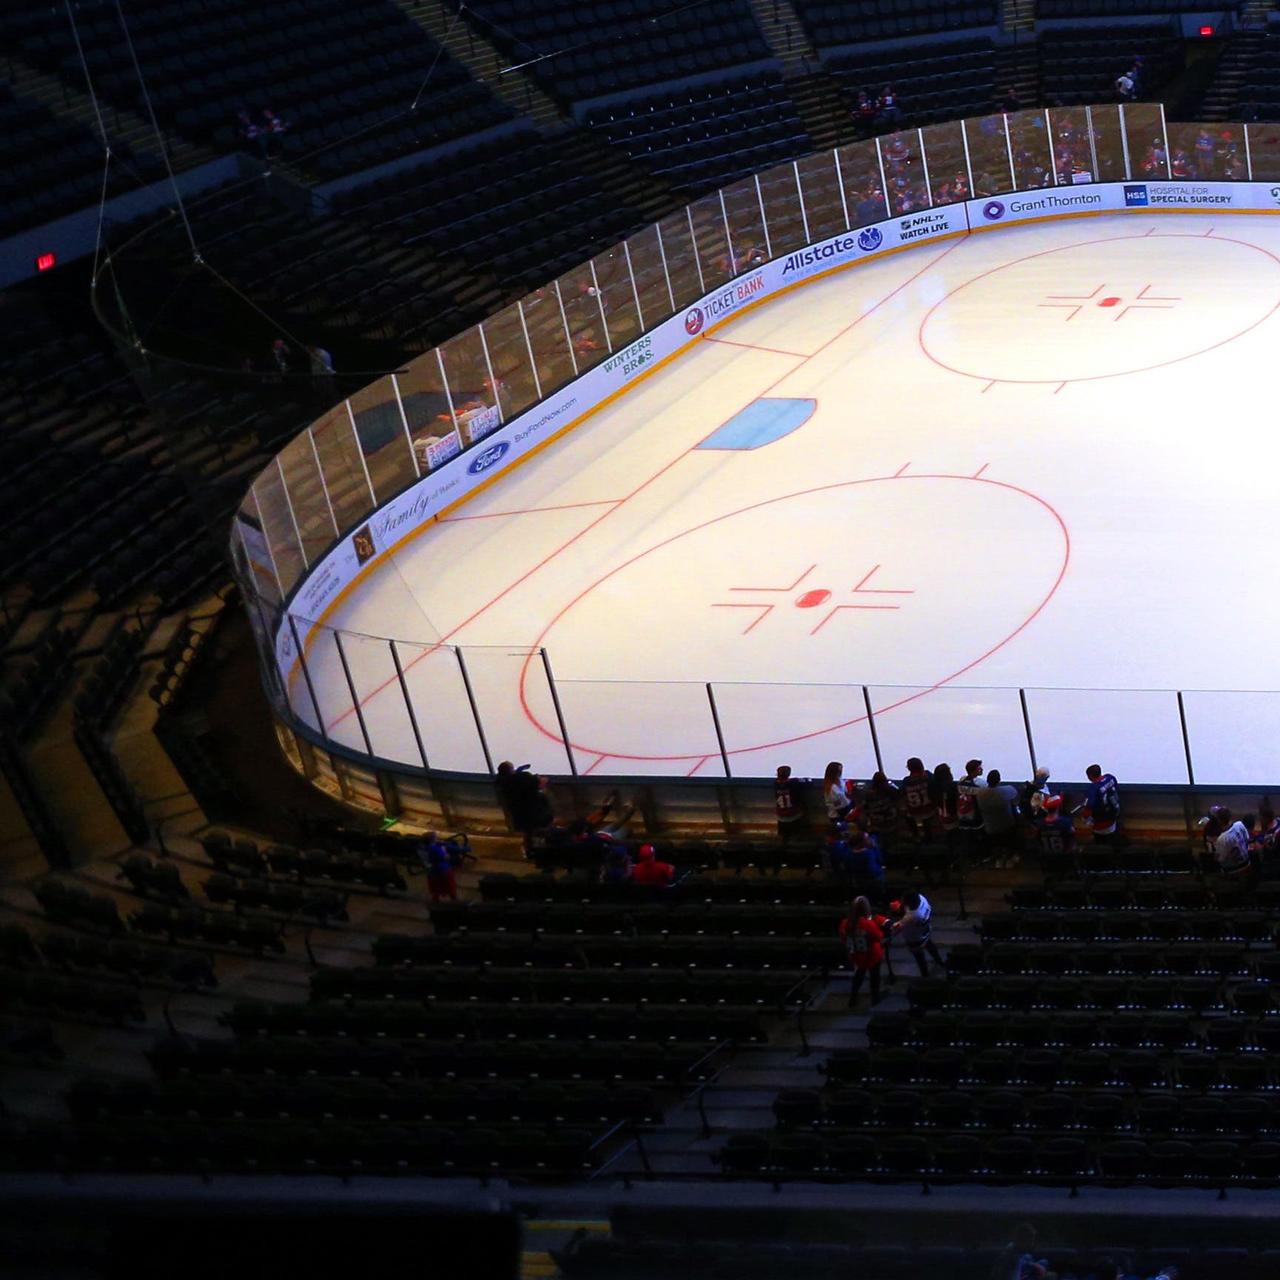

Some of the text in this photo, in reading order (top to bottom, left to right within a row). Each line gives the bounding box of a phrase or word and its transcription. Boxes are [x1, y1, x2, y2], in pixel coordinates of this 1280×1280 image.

[1126, 192, 1146, 200] HSS
[1150, 187, 1208, 195] HOSPITAL FOR
[1150, 195, 1232, 203] SPECIAL SURGERY
[1010, 195, 1101, 212] Grant Thornton
[900, 222, 950, 240] WATCH LIVE
[782, 238, 854, 275] Allstate
[704, 291, 735, 319] TICKET
[737, 276, 765, 299] BANK
[603, 336, 652, 373] WINTERS
[513, 397, 577, 442] BuyFordNow.com
[475, 446, 503, 471] Ford
